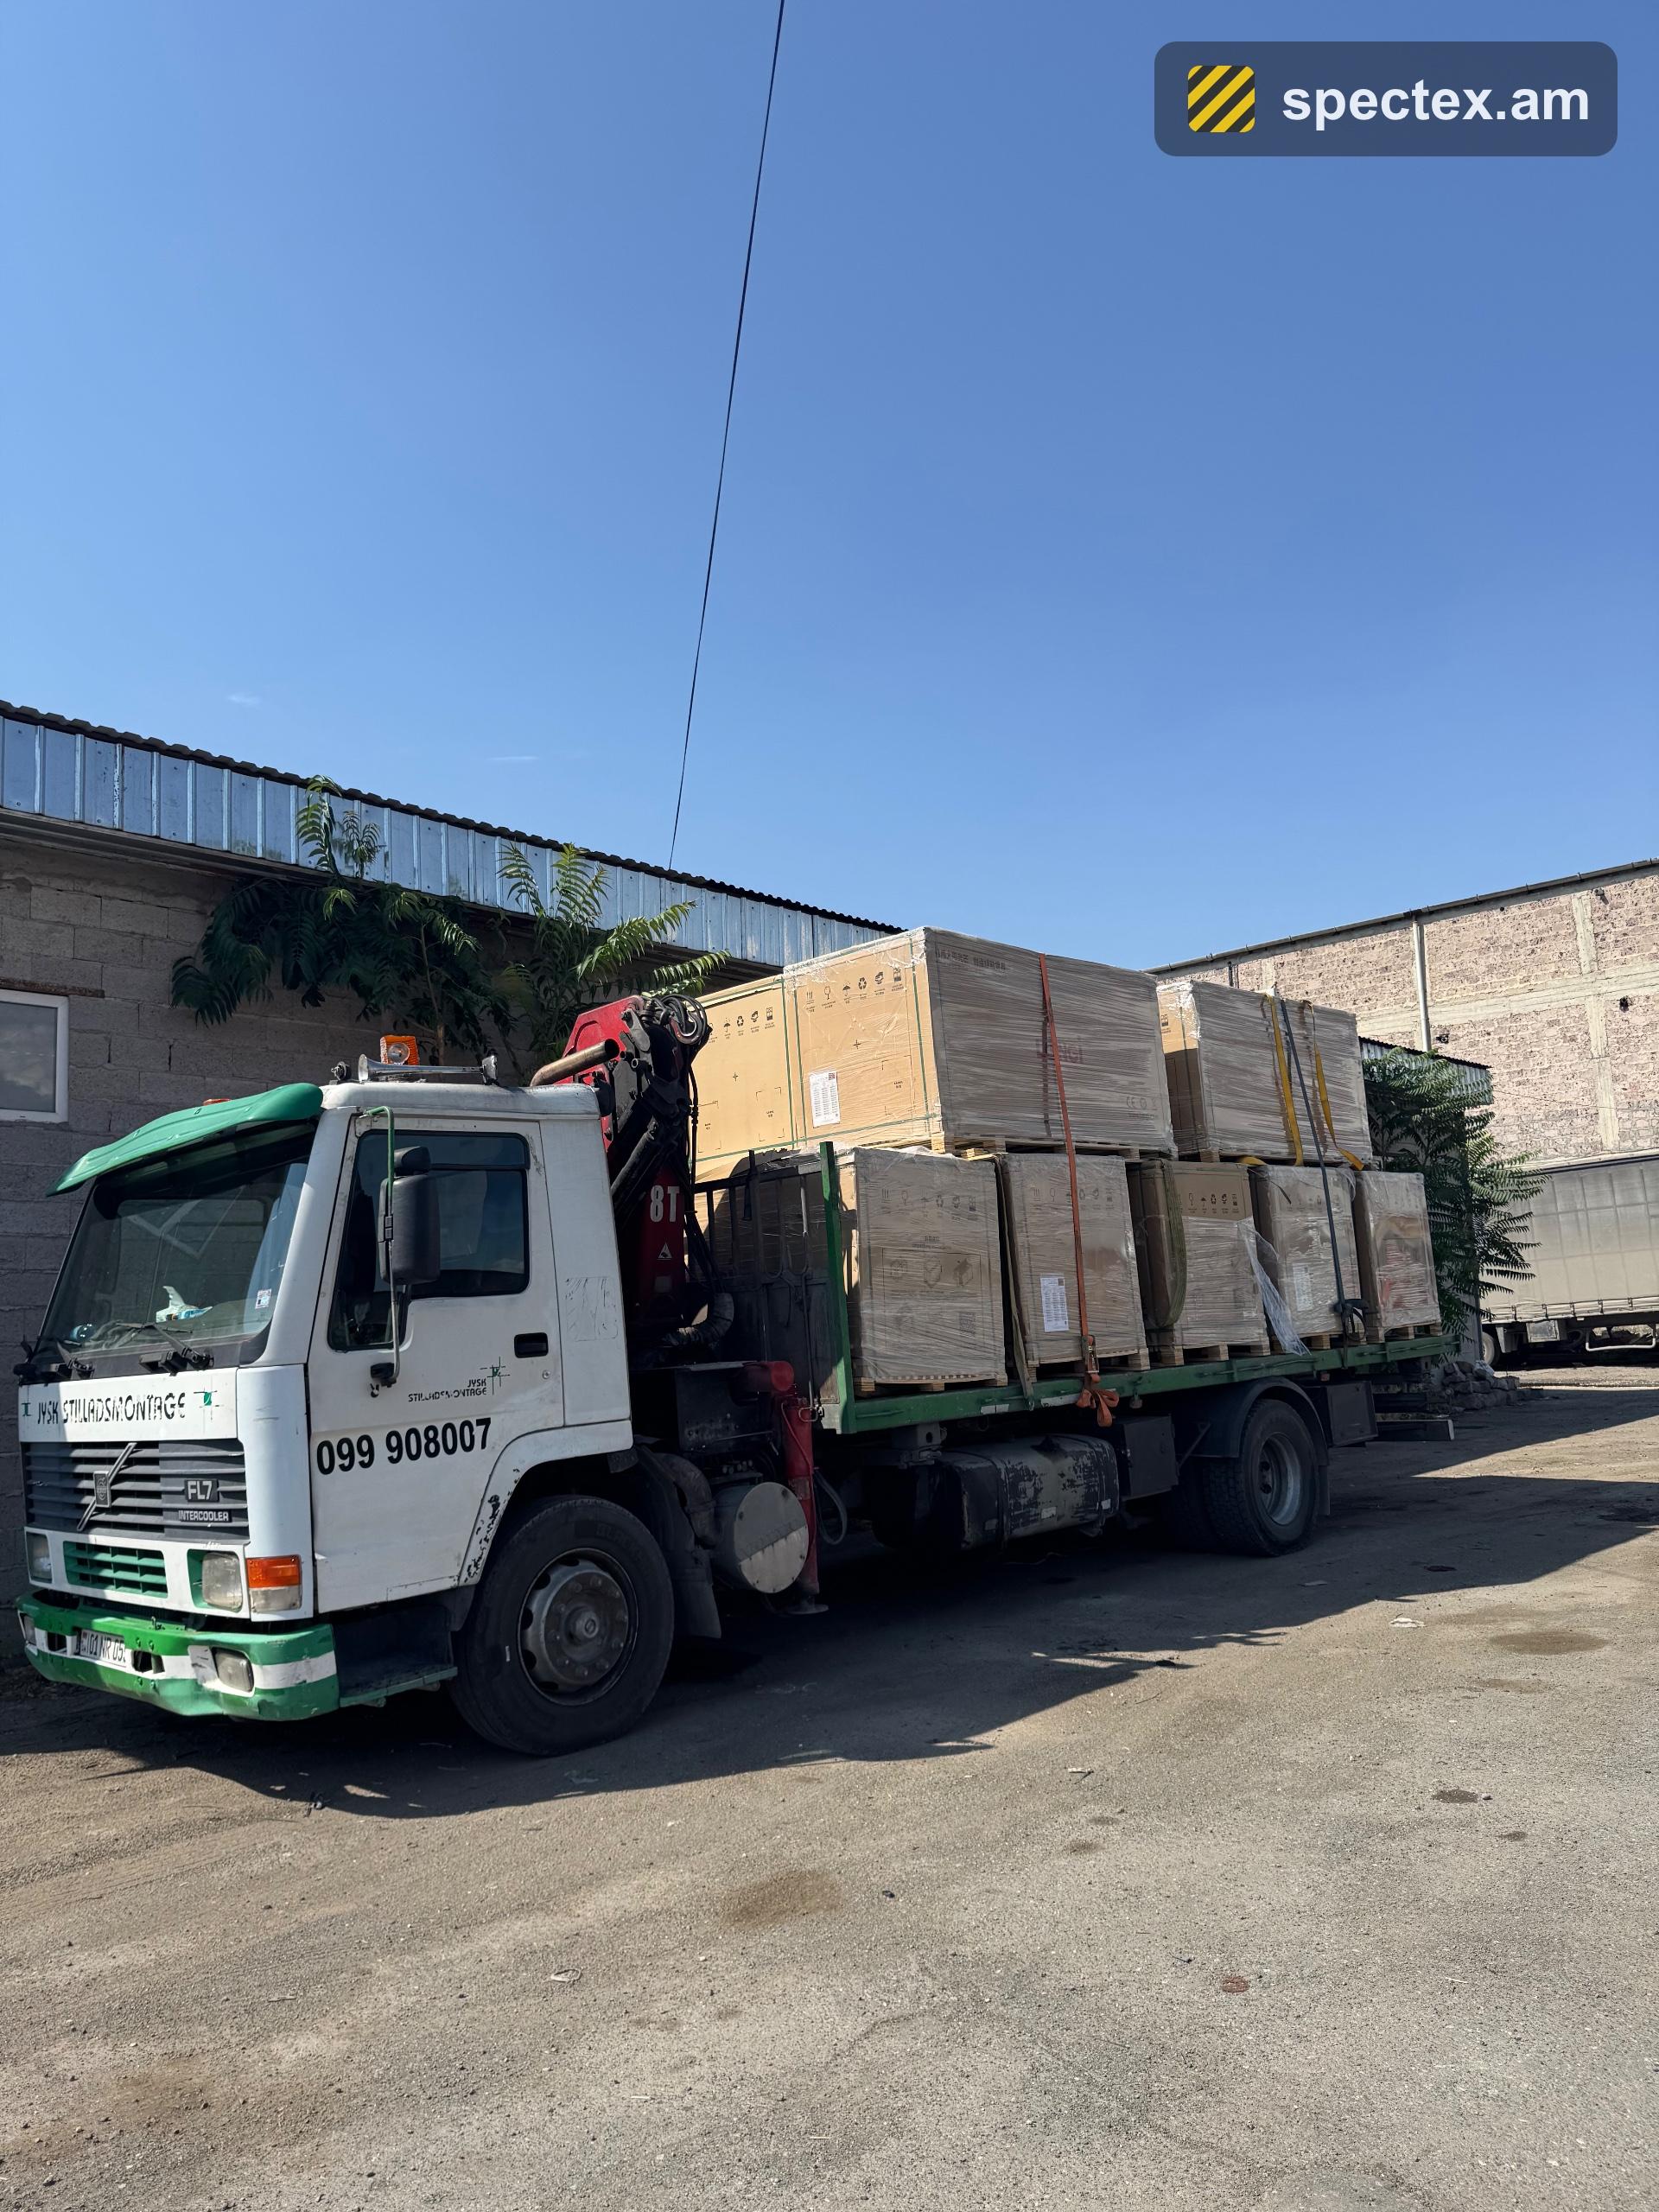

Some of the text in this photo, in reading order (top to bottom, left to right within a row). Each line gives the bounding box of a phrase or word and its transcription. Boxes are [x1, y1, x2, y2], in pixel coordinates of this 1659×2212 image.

[650, 1185, 680, 1223] 8T
[467, 1378, 486, 1389] JYSK
[37, 1400, 59, 1426] JYSK
[316, 1417, 492, 1476] 099 908007
[188, 1480, 213, 1500] FL7
[178, 1510, 229, 1522] INTERCOOLER
